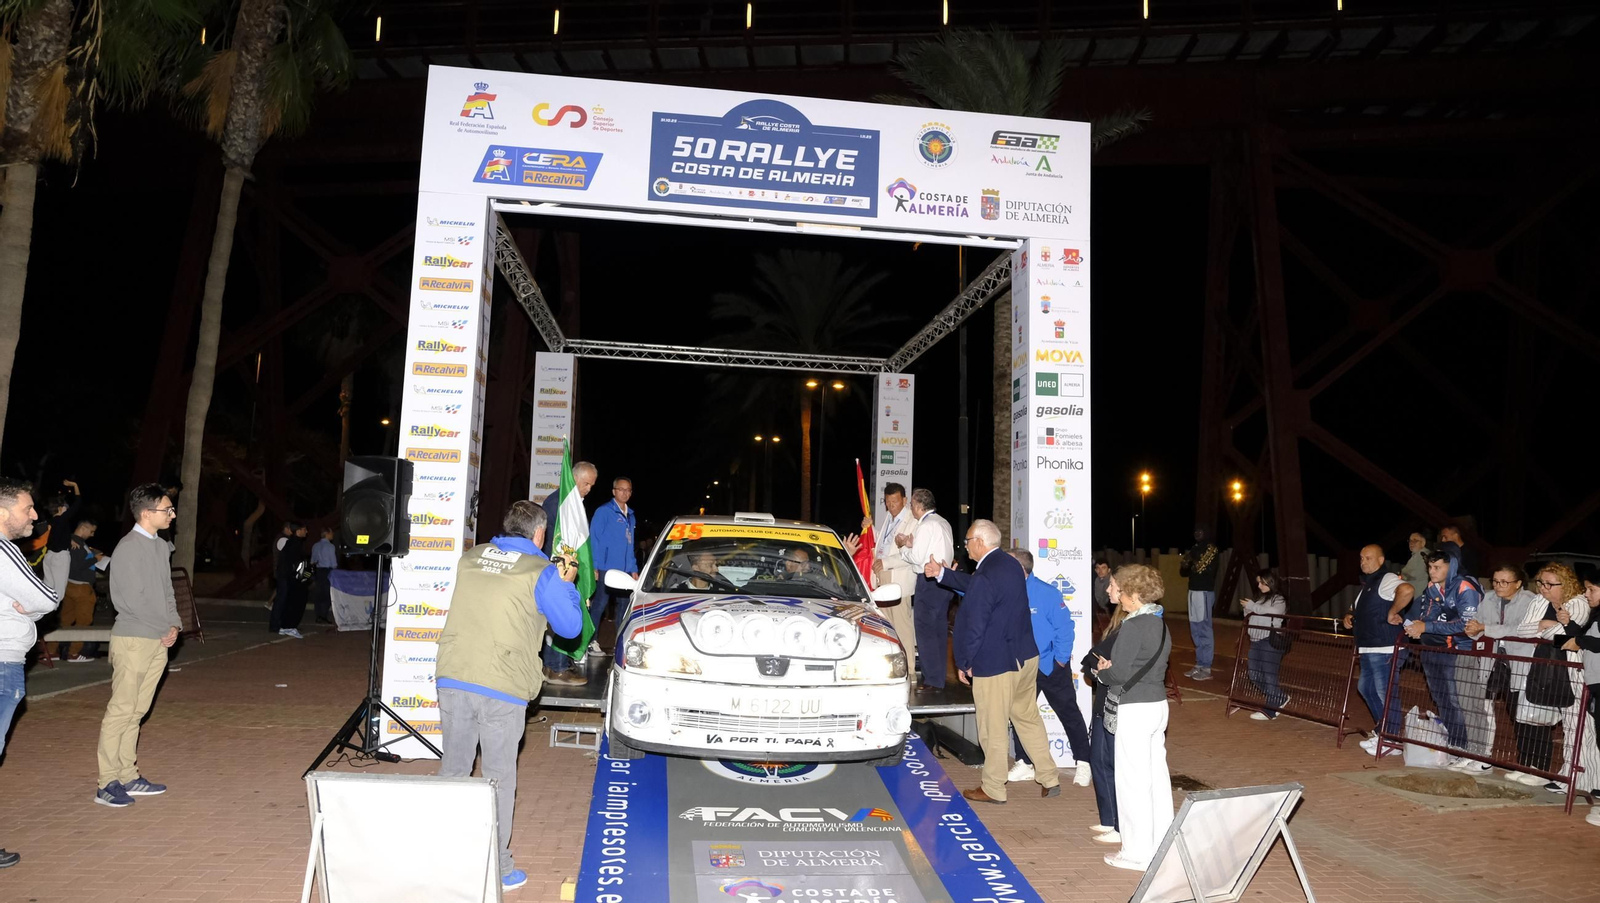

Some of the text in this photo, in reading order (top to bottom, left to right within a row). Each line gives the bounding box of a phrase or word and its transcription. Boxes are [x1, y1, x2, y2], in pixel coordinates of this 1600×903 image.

[756, 120, 779, 128] RALLYE
[672, 136, 858, 170] 50 RALLYE
[522, 152, 587, 168] CERA
[534, 172, 574, 184] Recalvi
[671, 162, 854, 187] COSTA DE ALMERÍA
[919, 192, 968, 204] COSTA DE
[908, 202, 969, 218] ALMERÍA
[1006, 200, 1072, 214] DIPUTACIÓN
[1006, 211, 1070, 224] DE ALMERÍA
[424, 256, 472, 268] Rallycar
[430, 280, 463, 290] Recalvi
[418, 340, 466, 352] Rallycar
[1036, 349, 1084, 363] MOYA
[423, 365, 457, 374] Recalvi
[1036, 404, 1084, 418] gasolia
[411, 426, 460, 438] Rallycar
[416, 450, 450, 460] Recalvi
[1037, 456, 1084, 470] Phonika
[670, 524, 704, 540] 35
[410, 538, 444, 548] Recalvi
[477, 558, 514, 570] FOTO/TV
[482, 566, 502, 574] 2025
[404, 630, 438, 640] Recalvi
[392, 696, 440, 708] Rallyca
[731, 698, 822, 714] M 6122 UU
[706, 734, 722, 744] VA
[785, 736, 822, 746] PAPÁ
[758, 849, 880, 858] DIPUTACIÓN
[795, 857, 884, 866] ALMERÍA
[792, 888, 895, 897] COSTA DE
